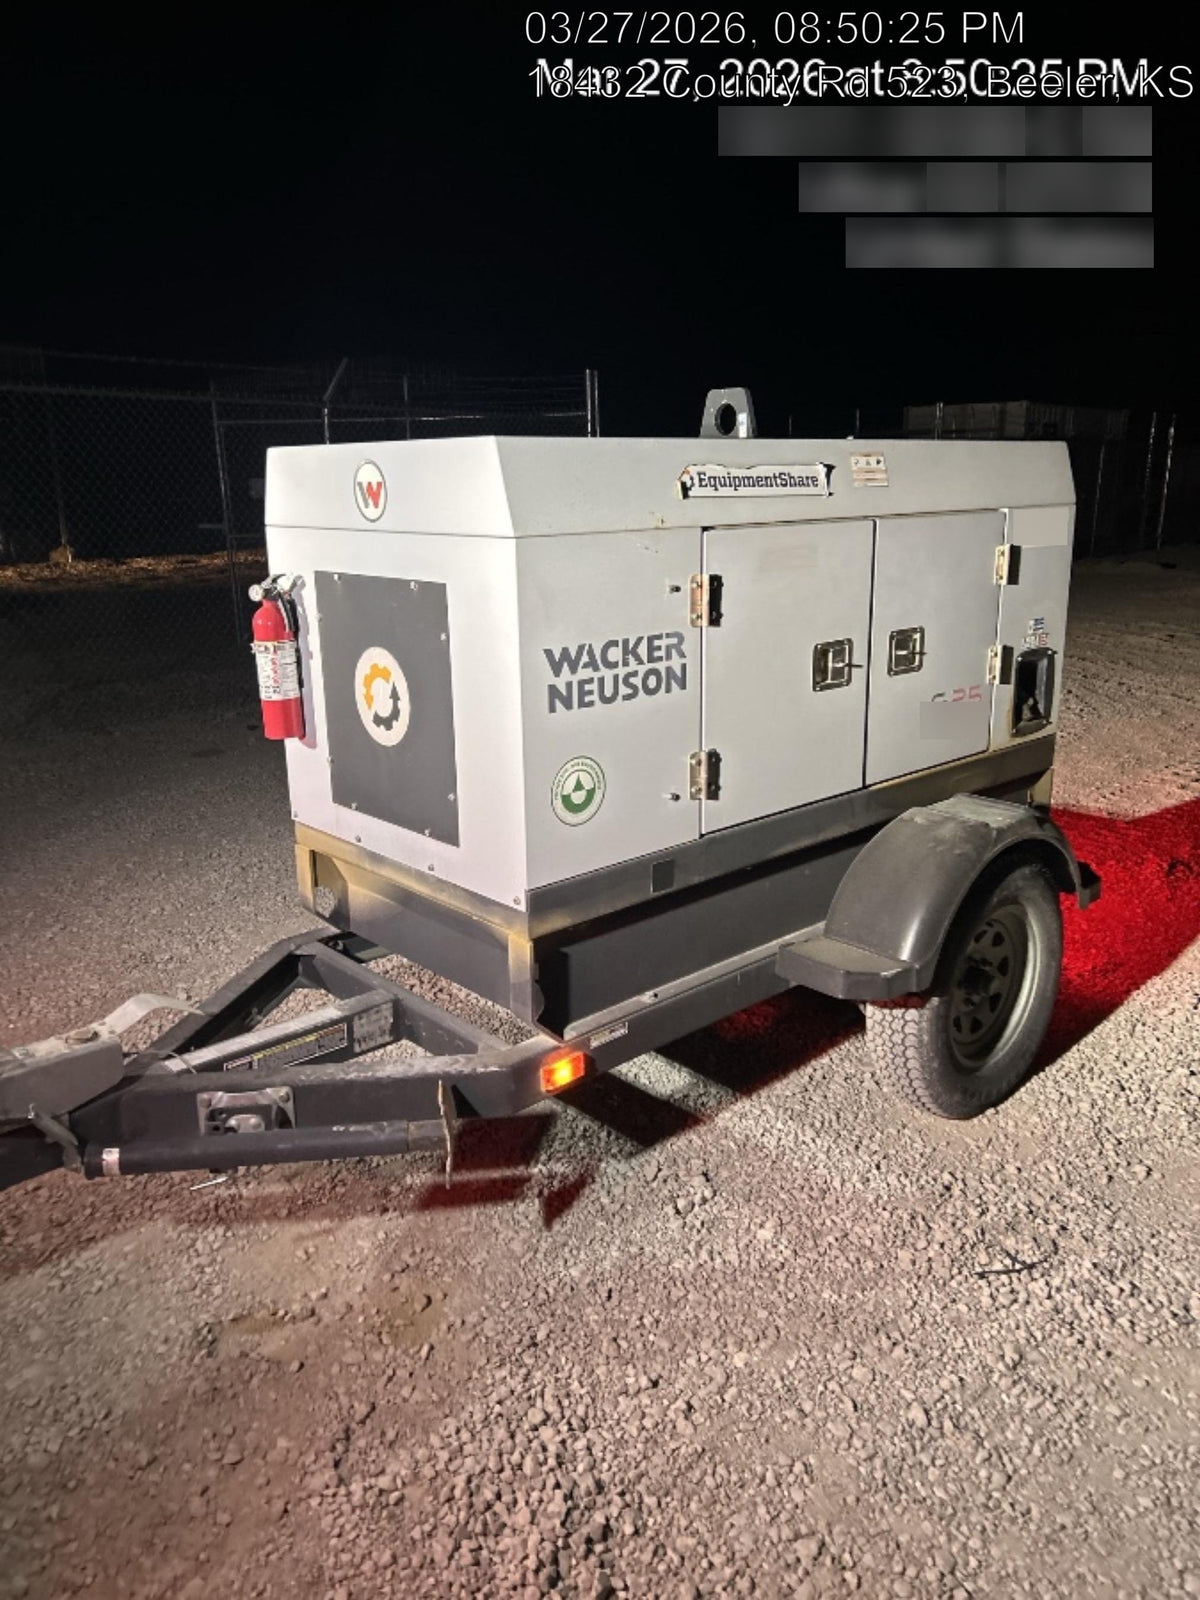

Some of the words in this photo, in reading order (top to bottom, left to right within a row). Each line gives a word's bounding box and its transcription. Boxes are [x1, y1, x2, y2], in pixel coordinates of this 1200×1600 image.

[356, 481, 383, 508] W
[696, 471, 819, 492] EquipmentShare
[542, 631, 687, 678] WACKER
[547, 662, 687, 714] NEUSON
